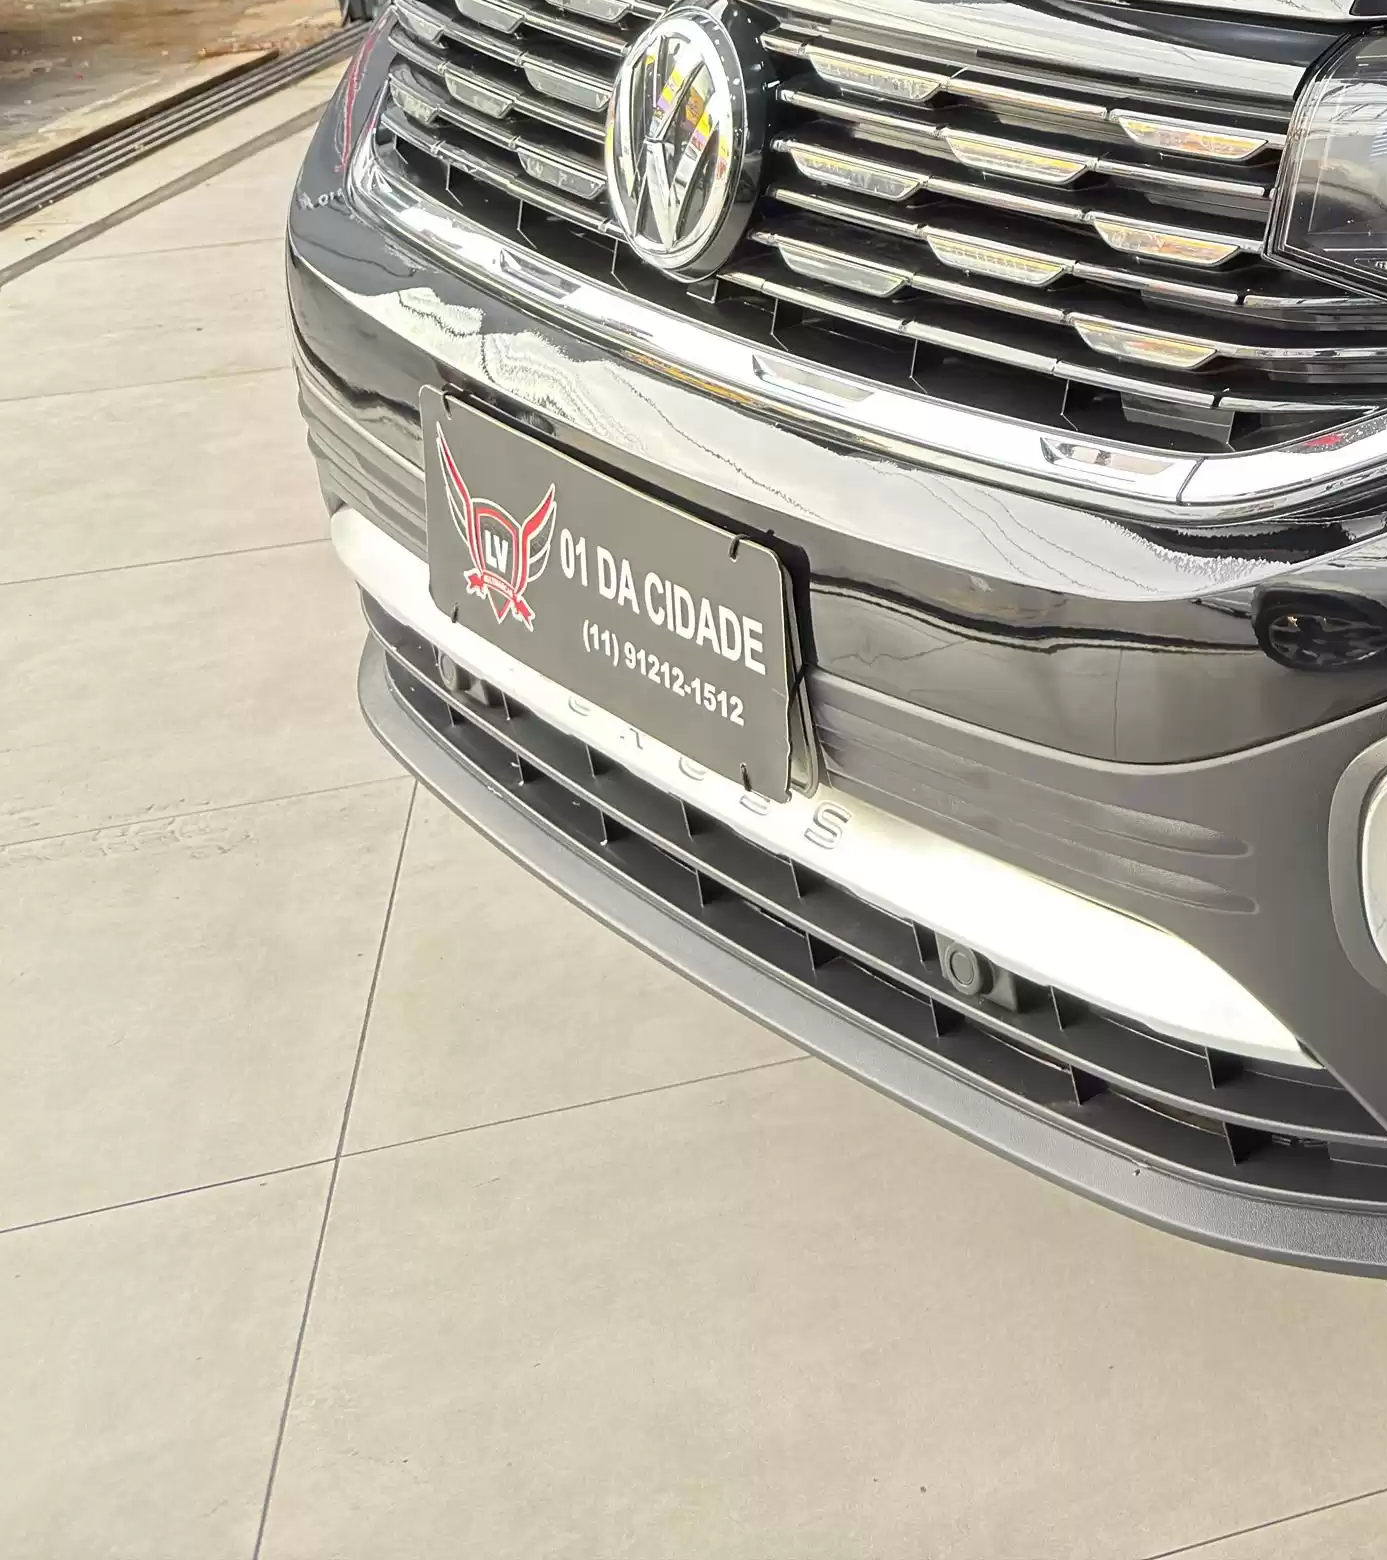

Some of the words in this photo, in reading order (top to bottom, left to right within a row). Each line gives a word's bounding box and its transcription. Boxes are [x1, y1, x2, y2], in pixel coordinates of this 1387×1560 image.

[484, 529, 509, 574] LV
[560, 527, 588, 587] 01
[596, 545, 640, 615] DA
[644, 571, 766, 676] CIDADE
[582, 619, 620, 667] (11)
[623, 641, 745, 727] 91212-1512
